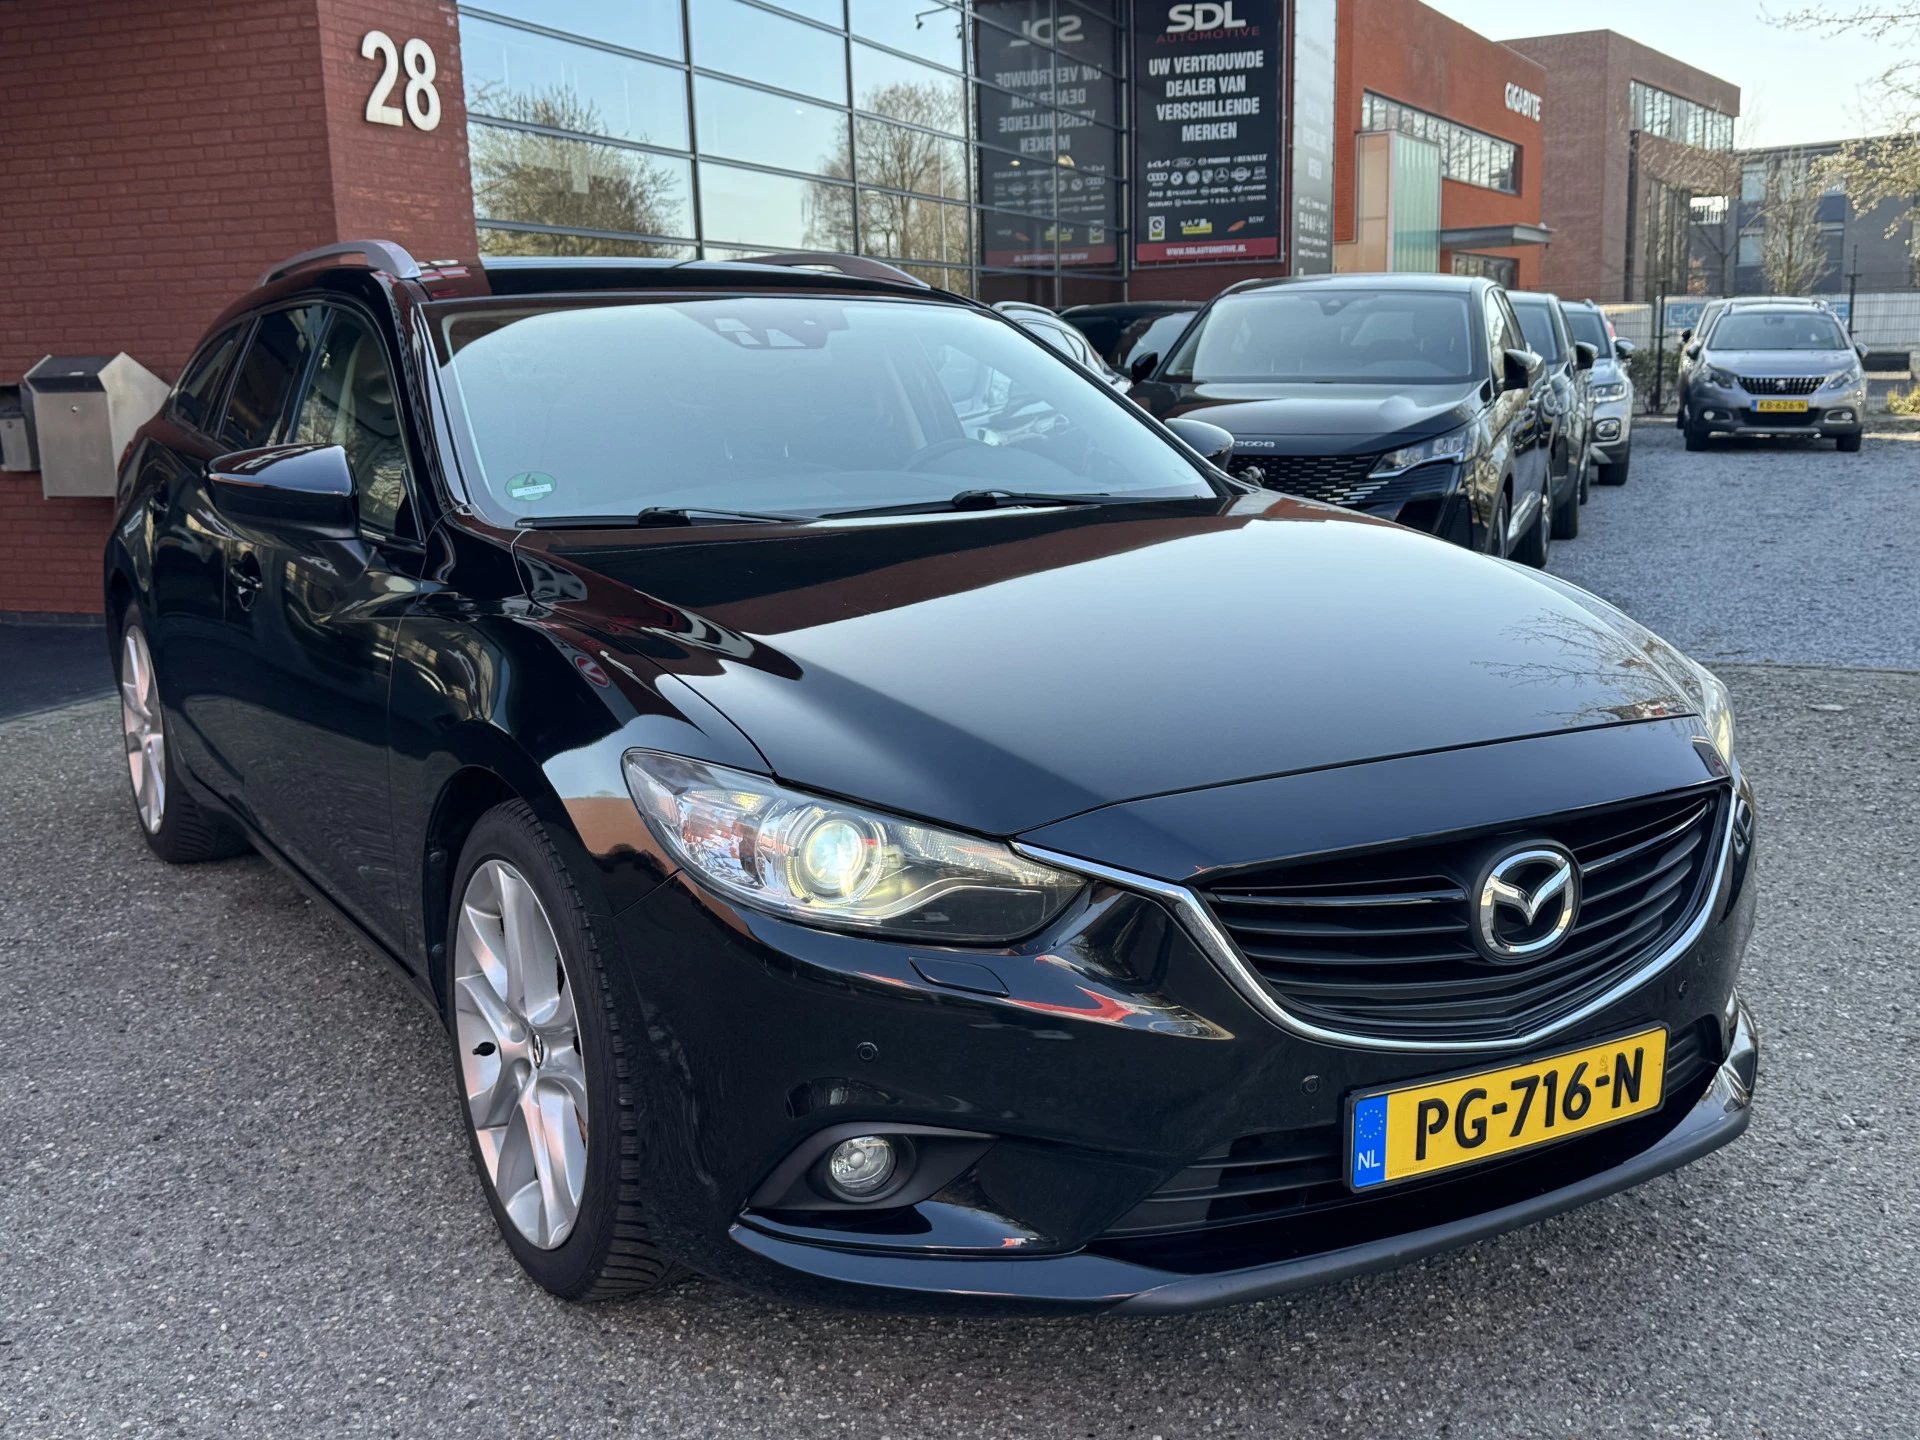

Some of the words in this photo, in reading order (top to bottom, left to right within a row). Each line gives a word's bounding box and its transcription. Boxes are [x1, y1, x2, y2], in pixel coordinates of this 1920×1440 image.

[1166, 1, 1247, 33] SDL
[1156, 26, 1261, 44] AUTOMOTIVE
[1148, 58, 1171, 76] UW
[1174, 50, 1264, 75] VERTROUWDE
[361, 30, 441, 131] 28
[1166, 78, 1216, 98] DEALER
[1219, 75, 1247, 94] VAN
[1156, 97, 1260, 122] VERSCHILLENDE
[1505, 82, 1543, 122] GIGABYTE
[1182, 121, 1237, 142] MERKEN
[1415, 1047, 1644, 1161] PG-716-N
[1357, 1149, 1381, 1171] NL
